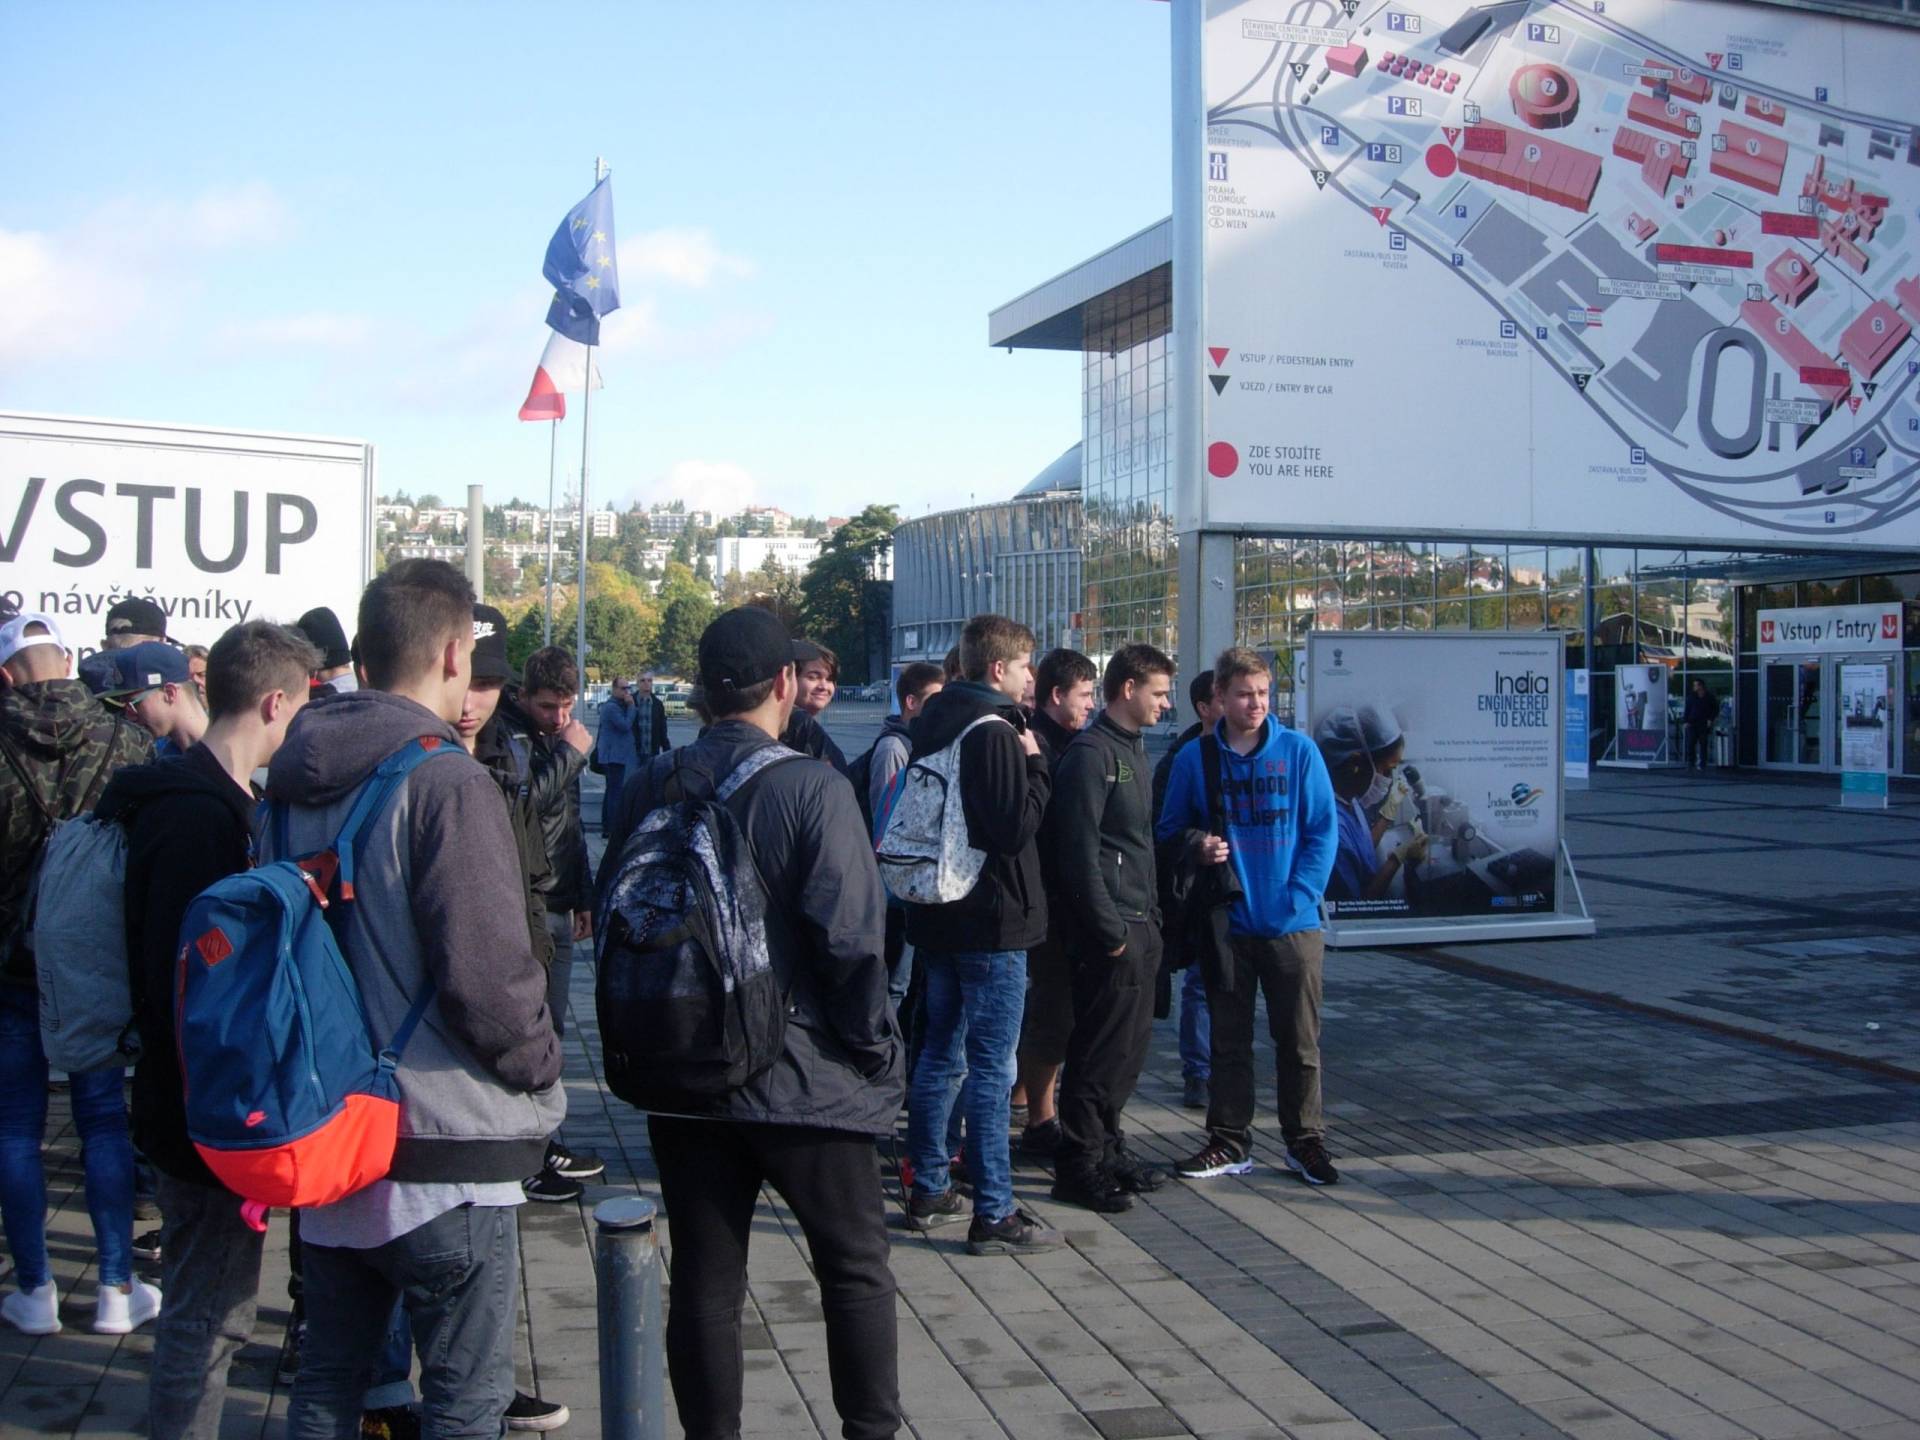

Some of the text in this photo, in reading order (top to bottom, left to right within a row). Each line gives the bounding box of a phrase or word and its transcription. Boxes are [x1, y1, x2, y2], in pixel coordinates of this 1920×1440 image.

[1344, 1, 1357, 11] 10
[1405, 17, 1419, 30] 10
[1317, 171, 1325, 184] 8
[1208, 185, 1236, 194] PRAHA
[1208, 194, 1247, 204] OLOMOUC
[1226, 208, 1276, 219] BRATISLAVA
[1226, 220, 1248, 229] WIEN
[1239, 353, 1266, 364] VSTUP
[1276, 355, 1327, 367] PEDESTRIAN
[1329, 358, 1354, 368] ENTRY
[1239, 381, 1266, 392] VJEZD
[1275, 383, 1301, 393] ENTRY
[1303, 385, 1315, 394] BY
[1317, 385, 1334, 395] CAR
[1578, 375, 1586, 387] 5
[1248, 444, 1321, 461] ZDE STOJÍTE
[1248, 463, 1334, 478] YOU ARE HERE
[0, 477, 318, 575] VSTUP
[40, 583, 253, 623] návšvníky
[1779, 621, 1822, 645] Vstup
[1836, 619, 1877, 643] Entry
[1495, 670, 1549, 694] India
[1478, 695, 1549, 711] ENGINEERED
[1494, 711, 1508, 727] TO
[1511, 711, 1549, 727] EXCEL
[1494, 808, 1539, 819] engineering
